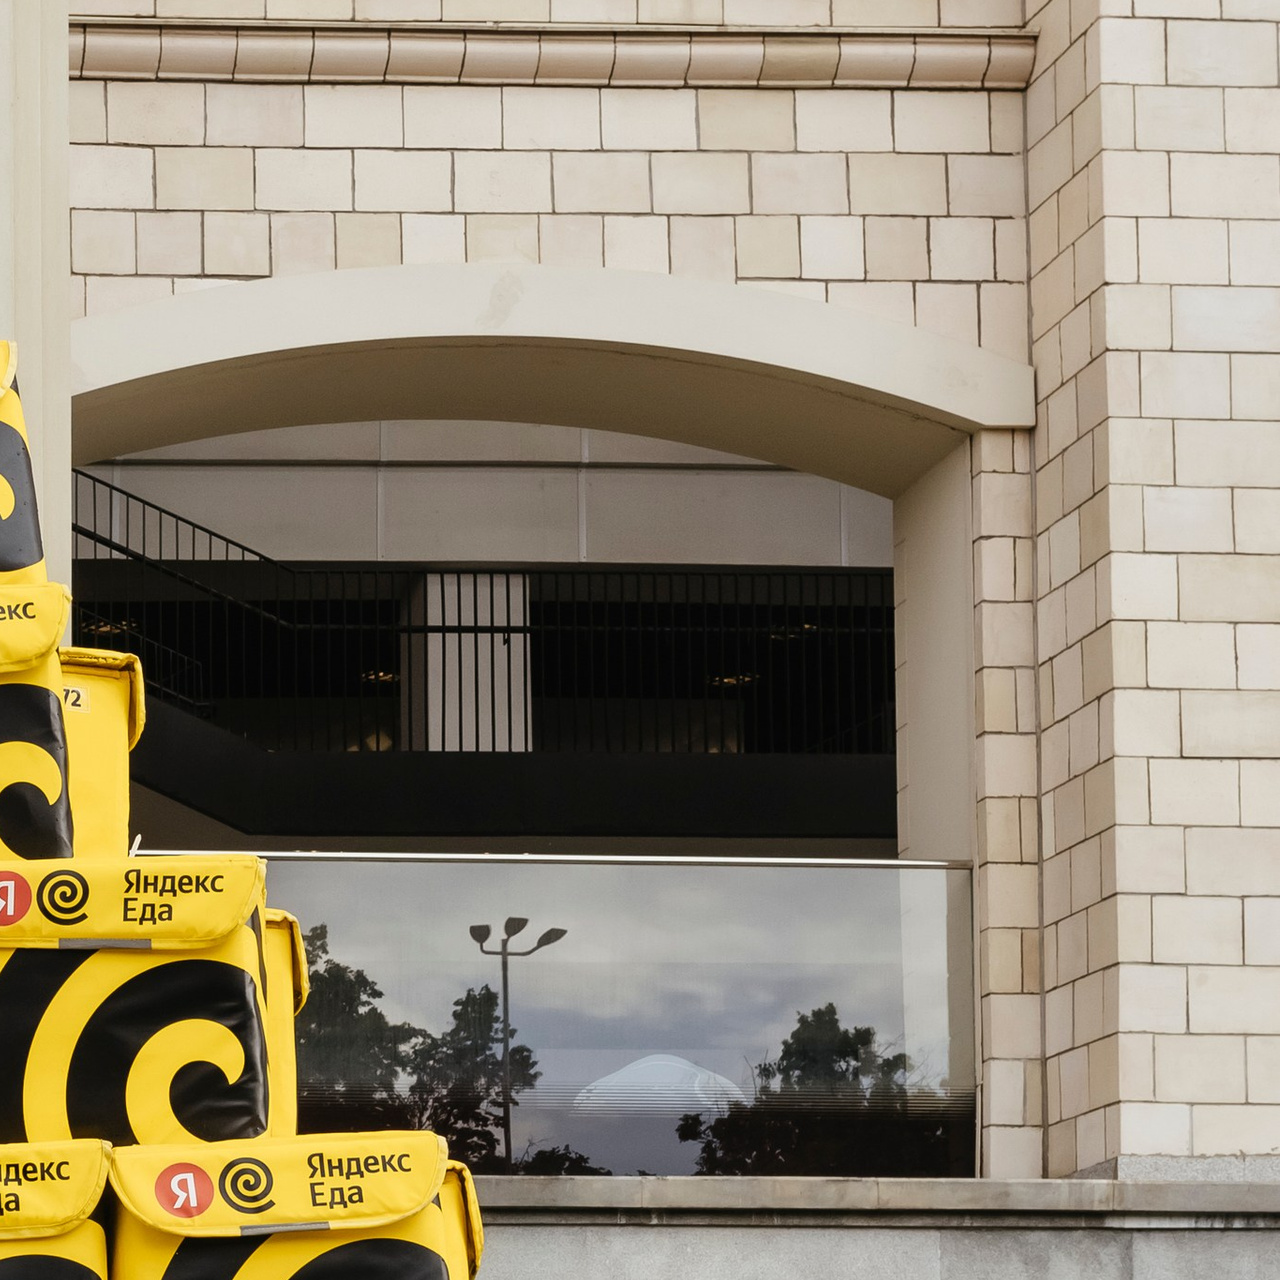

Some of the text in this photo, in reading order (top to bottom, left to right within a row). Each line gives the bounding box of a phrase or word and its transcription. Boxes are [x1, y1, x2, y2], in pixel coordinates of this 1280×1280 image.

[124, 869, 223, 897] Яндекс
[123, 898, 172, 925] Еда
[308, 1153, 411, 1179] Яндекс
[310, 1182, 363, 1209] Еда
